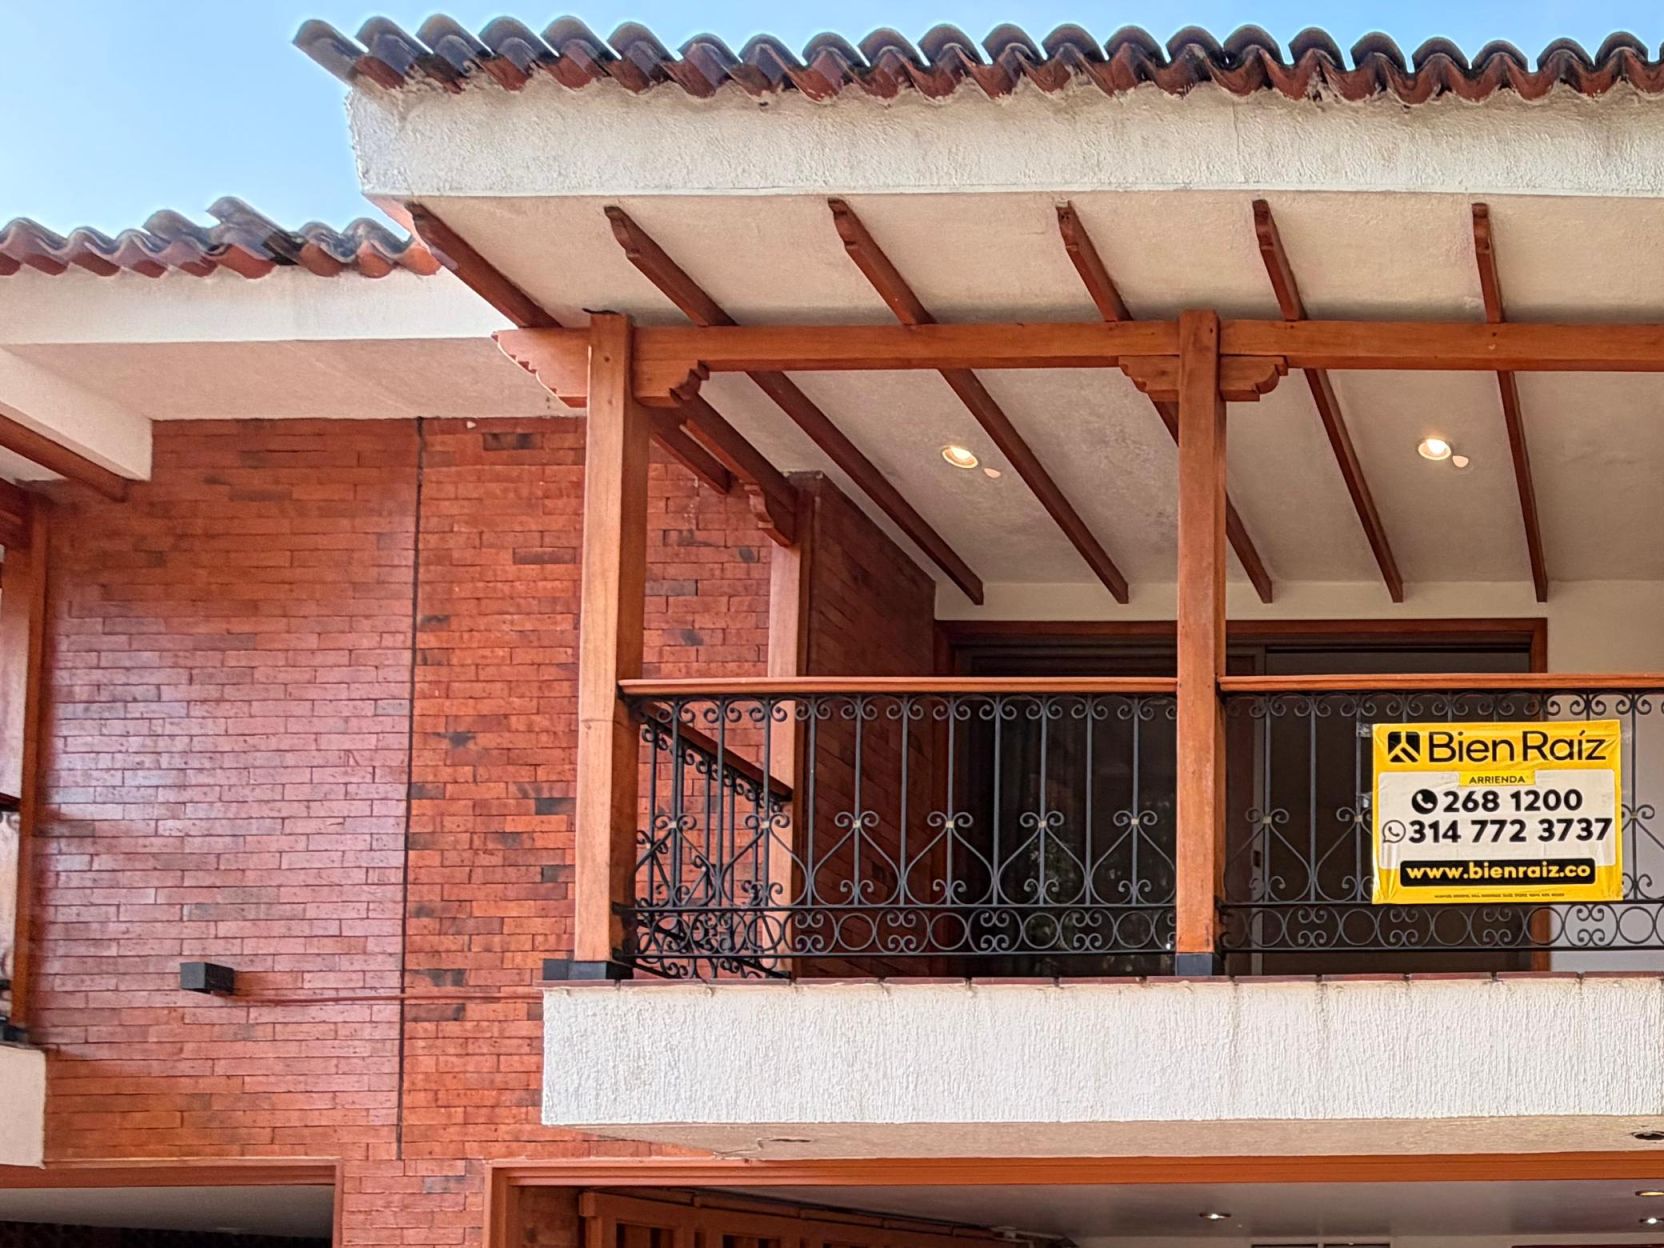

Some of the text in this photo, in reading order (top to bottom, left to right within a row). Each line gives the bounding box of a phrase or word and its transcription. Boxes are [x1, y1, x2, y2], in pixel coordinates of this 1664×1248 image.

[1428, 730, 1607, 763] Bien Raíz
[1468, 775, 1526, 784] ARRIENDA
[1443, 788, 1583, 813] 268 1200
[1408, 817, 1613, 844] 314 772 3737
[1405, 861, 1592, 880] www.bienraiz.co
